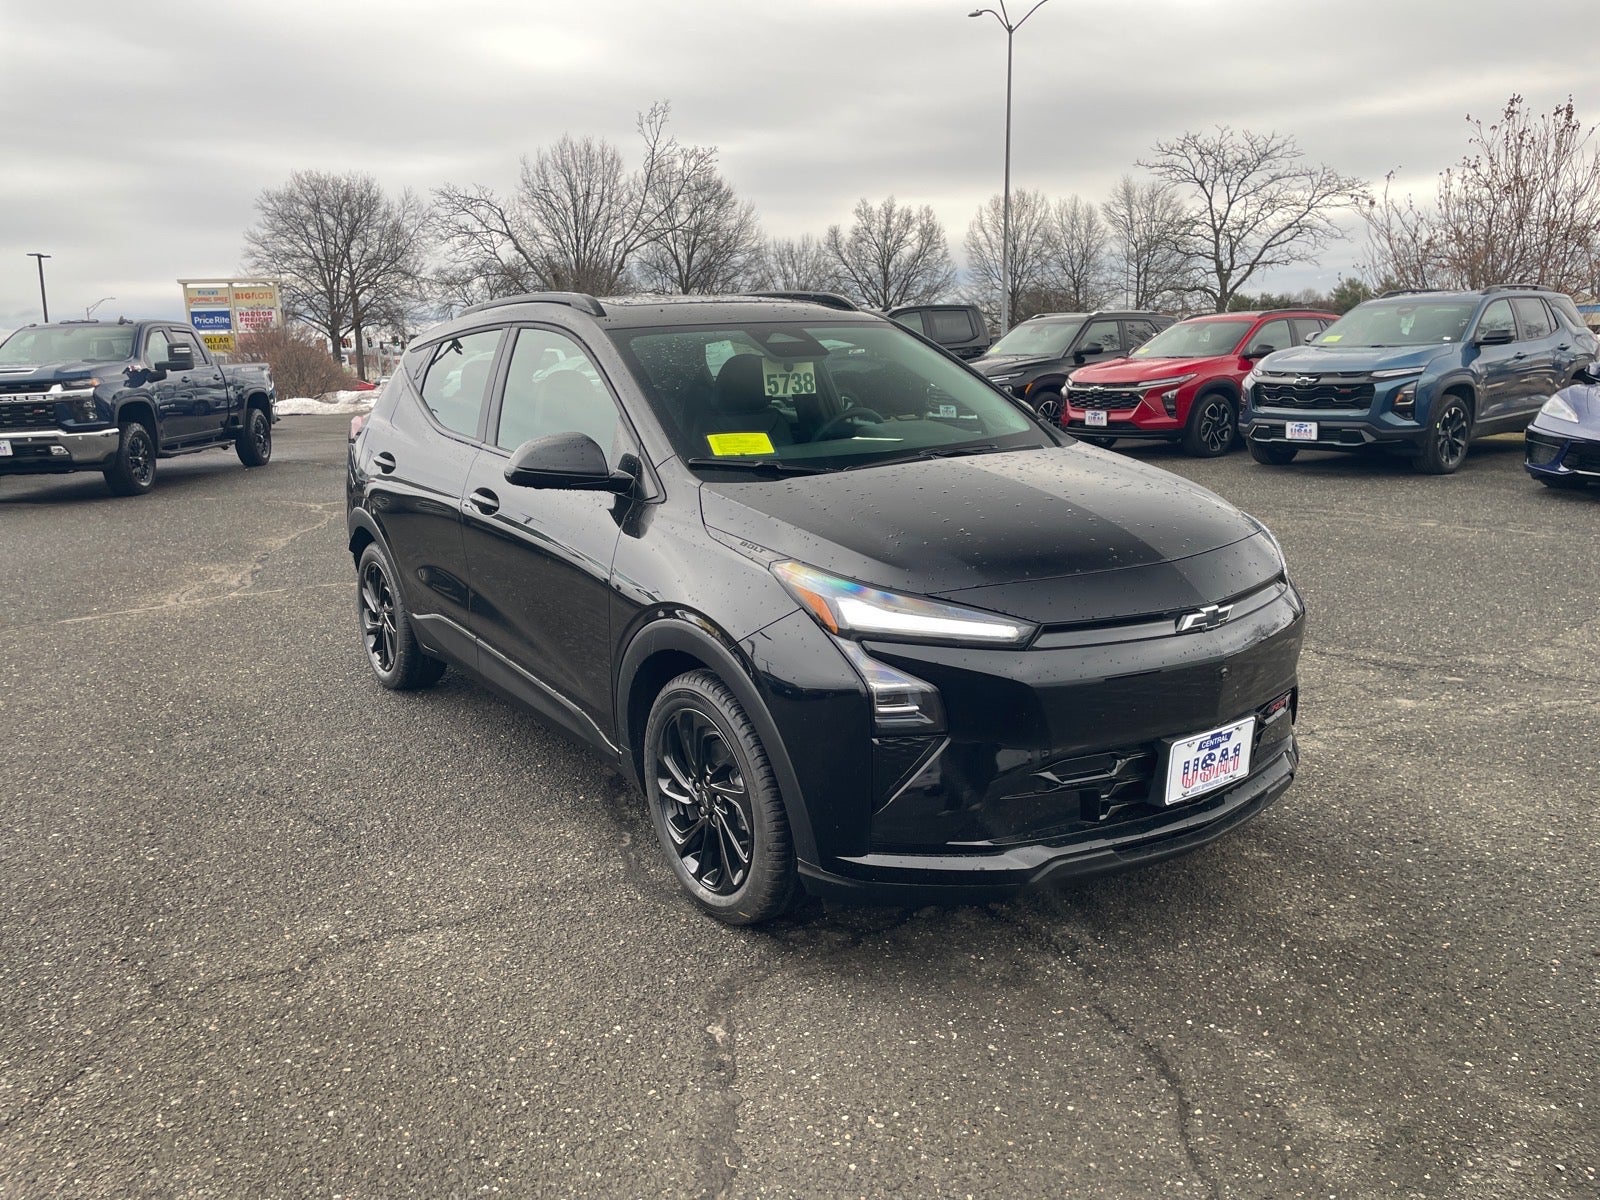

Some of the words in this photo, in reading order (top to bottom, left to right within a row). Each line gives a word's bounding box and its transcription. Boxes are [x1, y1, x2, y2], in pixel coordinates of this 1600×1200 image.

[193, 316, 214, 325] Price
[214, 316, 230, 324] Rite
[766, 372, 815, 395] 5738
[740, 540, 767, 553] BOLT
[1201, 734, 1229, 749] CENTRAL
